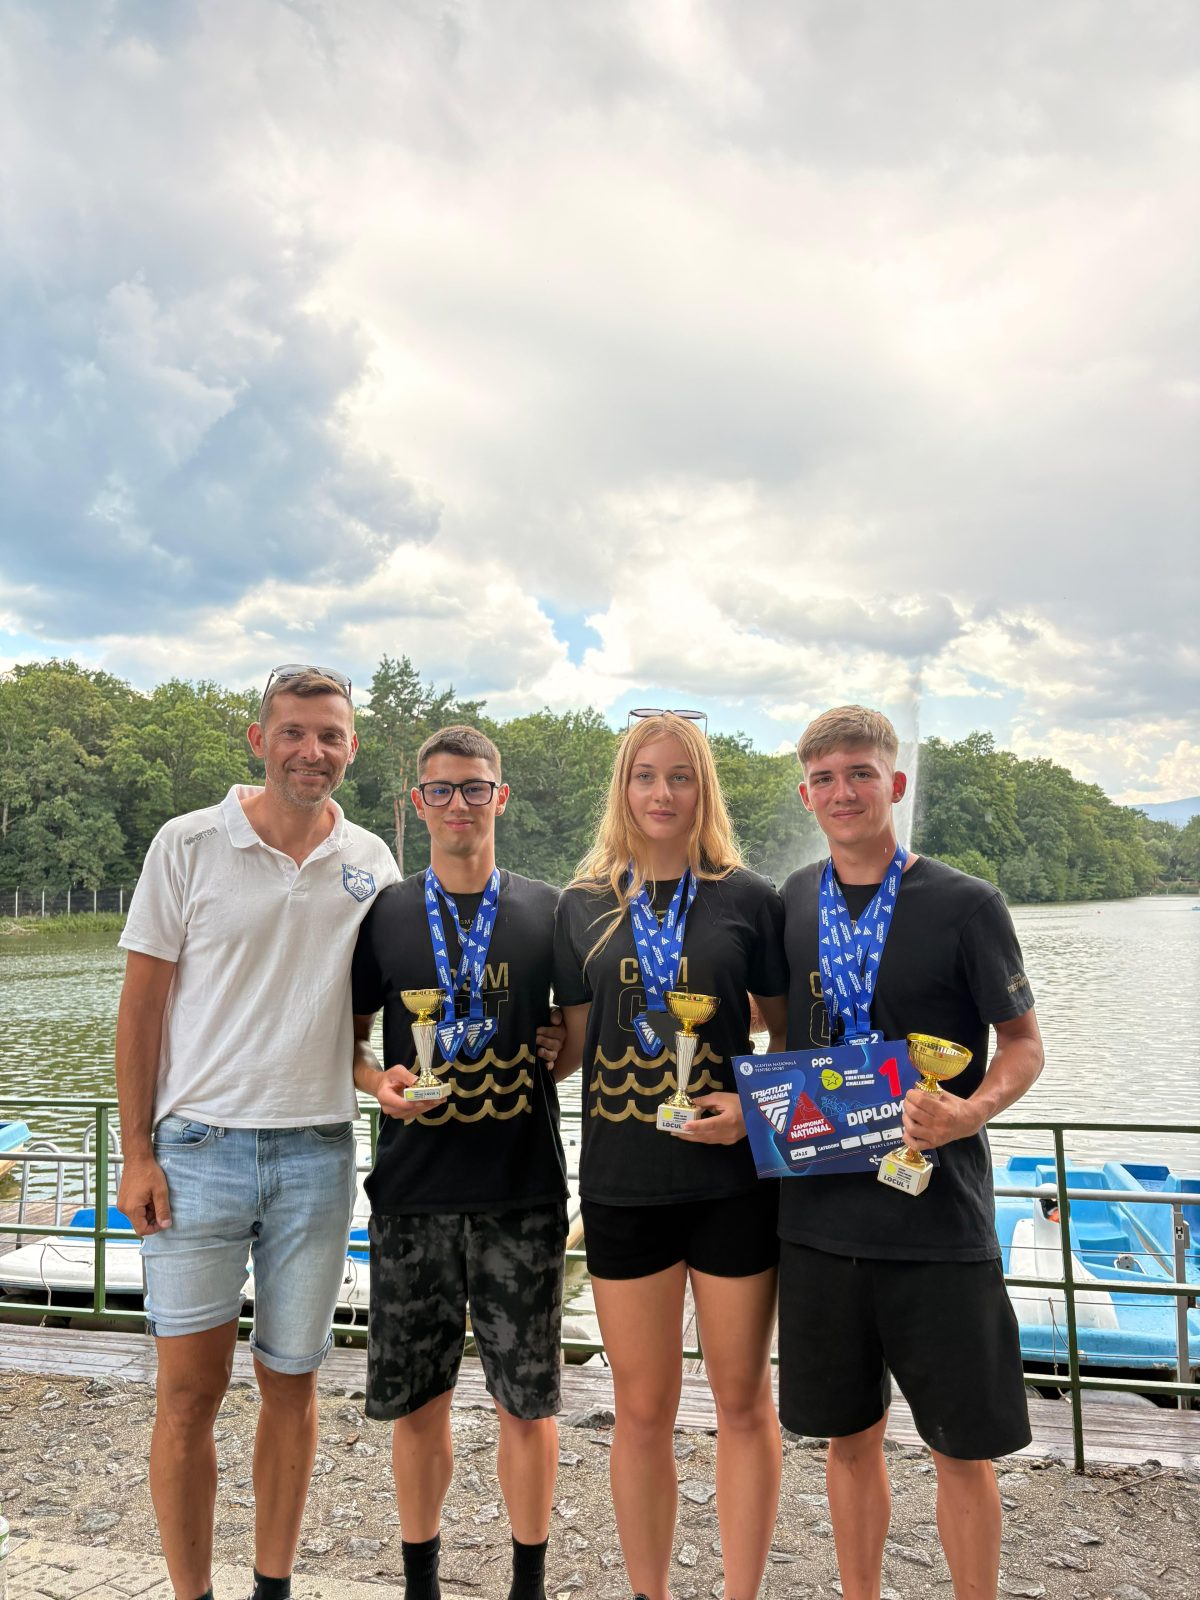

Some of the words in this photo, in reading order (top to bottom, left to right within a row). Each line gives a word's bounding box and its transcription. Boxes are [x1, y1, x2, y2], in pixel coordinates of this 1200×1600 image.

[457, 1021, 464, 1034] 3
[484, 1019, 493, 1031] 3
[871, 1033, 879, 1044] 2
[811, 1056, 833, 1068] ppc
[878, 1057, 903, 1098] 1
[751, 1082, 793, 1099] TRIATLON
[758, 1091, 788, 1104] ROMANIA
[847, 1100, 905, 1127] DIPLOM
[792, 1118, 825, 1131] CAMPIONAT
[883, 1175, 905, 1188] LOCUL
[1175, 1226, 1184, 1235] H
